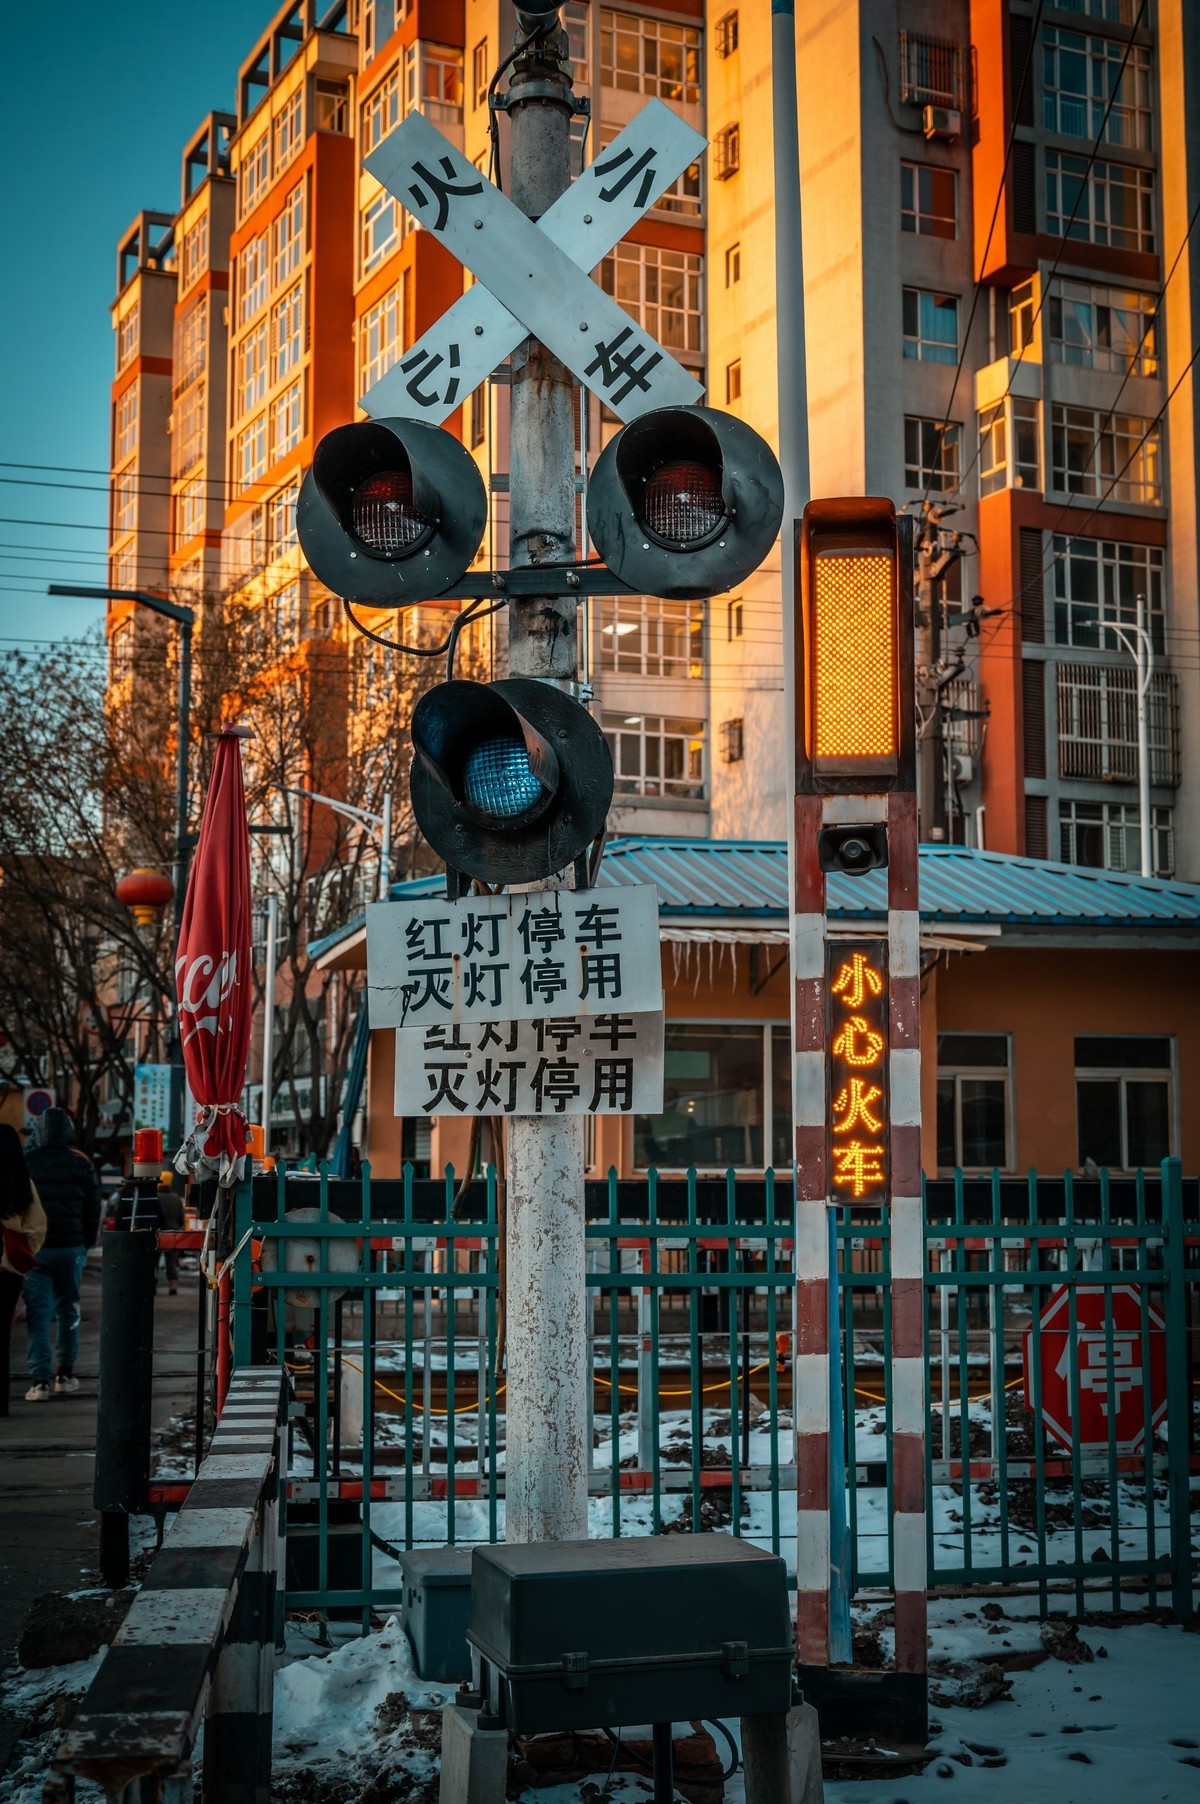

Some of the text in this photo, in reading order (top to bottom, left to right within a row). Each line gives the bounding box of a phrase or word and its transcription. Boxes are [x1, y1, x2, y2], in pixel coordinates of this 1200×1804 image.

[400, 146, 657, 407] 小 心
[408, 155, 664, 406] 火 车
[405, 903, 622, 961] 红灯停车
[407, 953, 623, 1012] 灭灯停用
[421, 1056, 634, 1113] 灭灯停用
[832, 953, 883, 1196] 小心火车
[1055, 1318, 1143, 1417] 停
